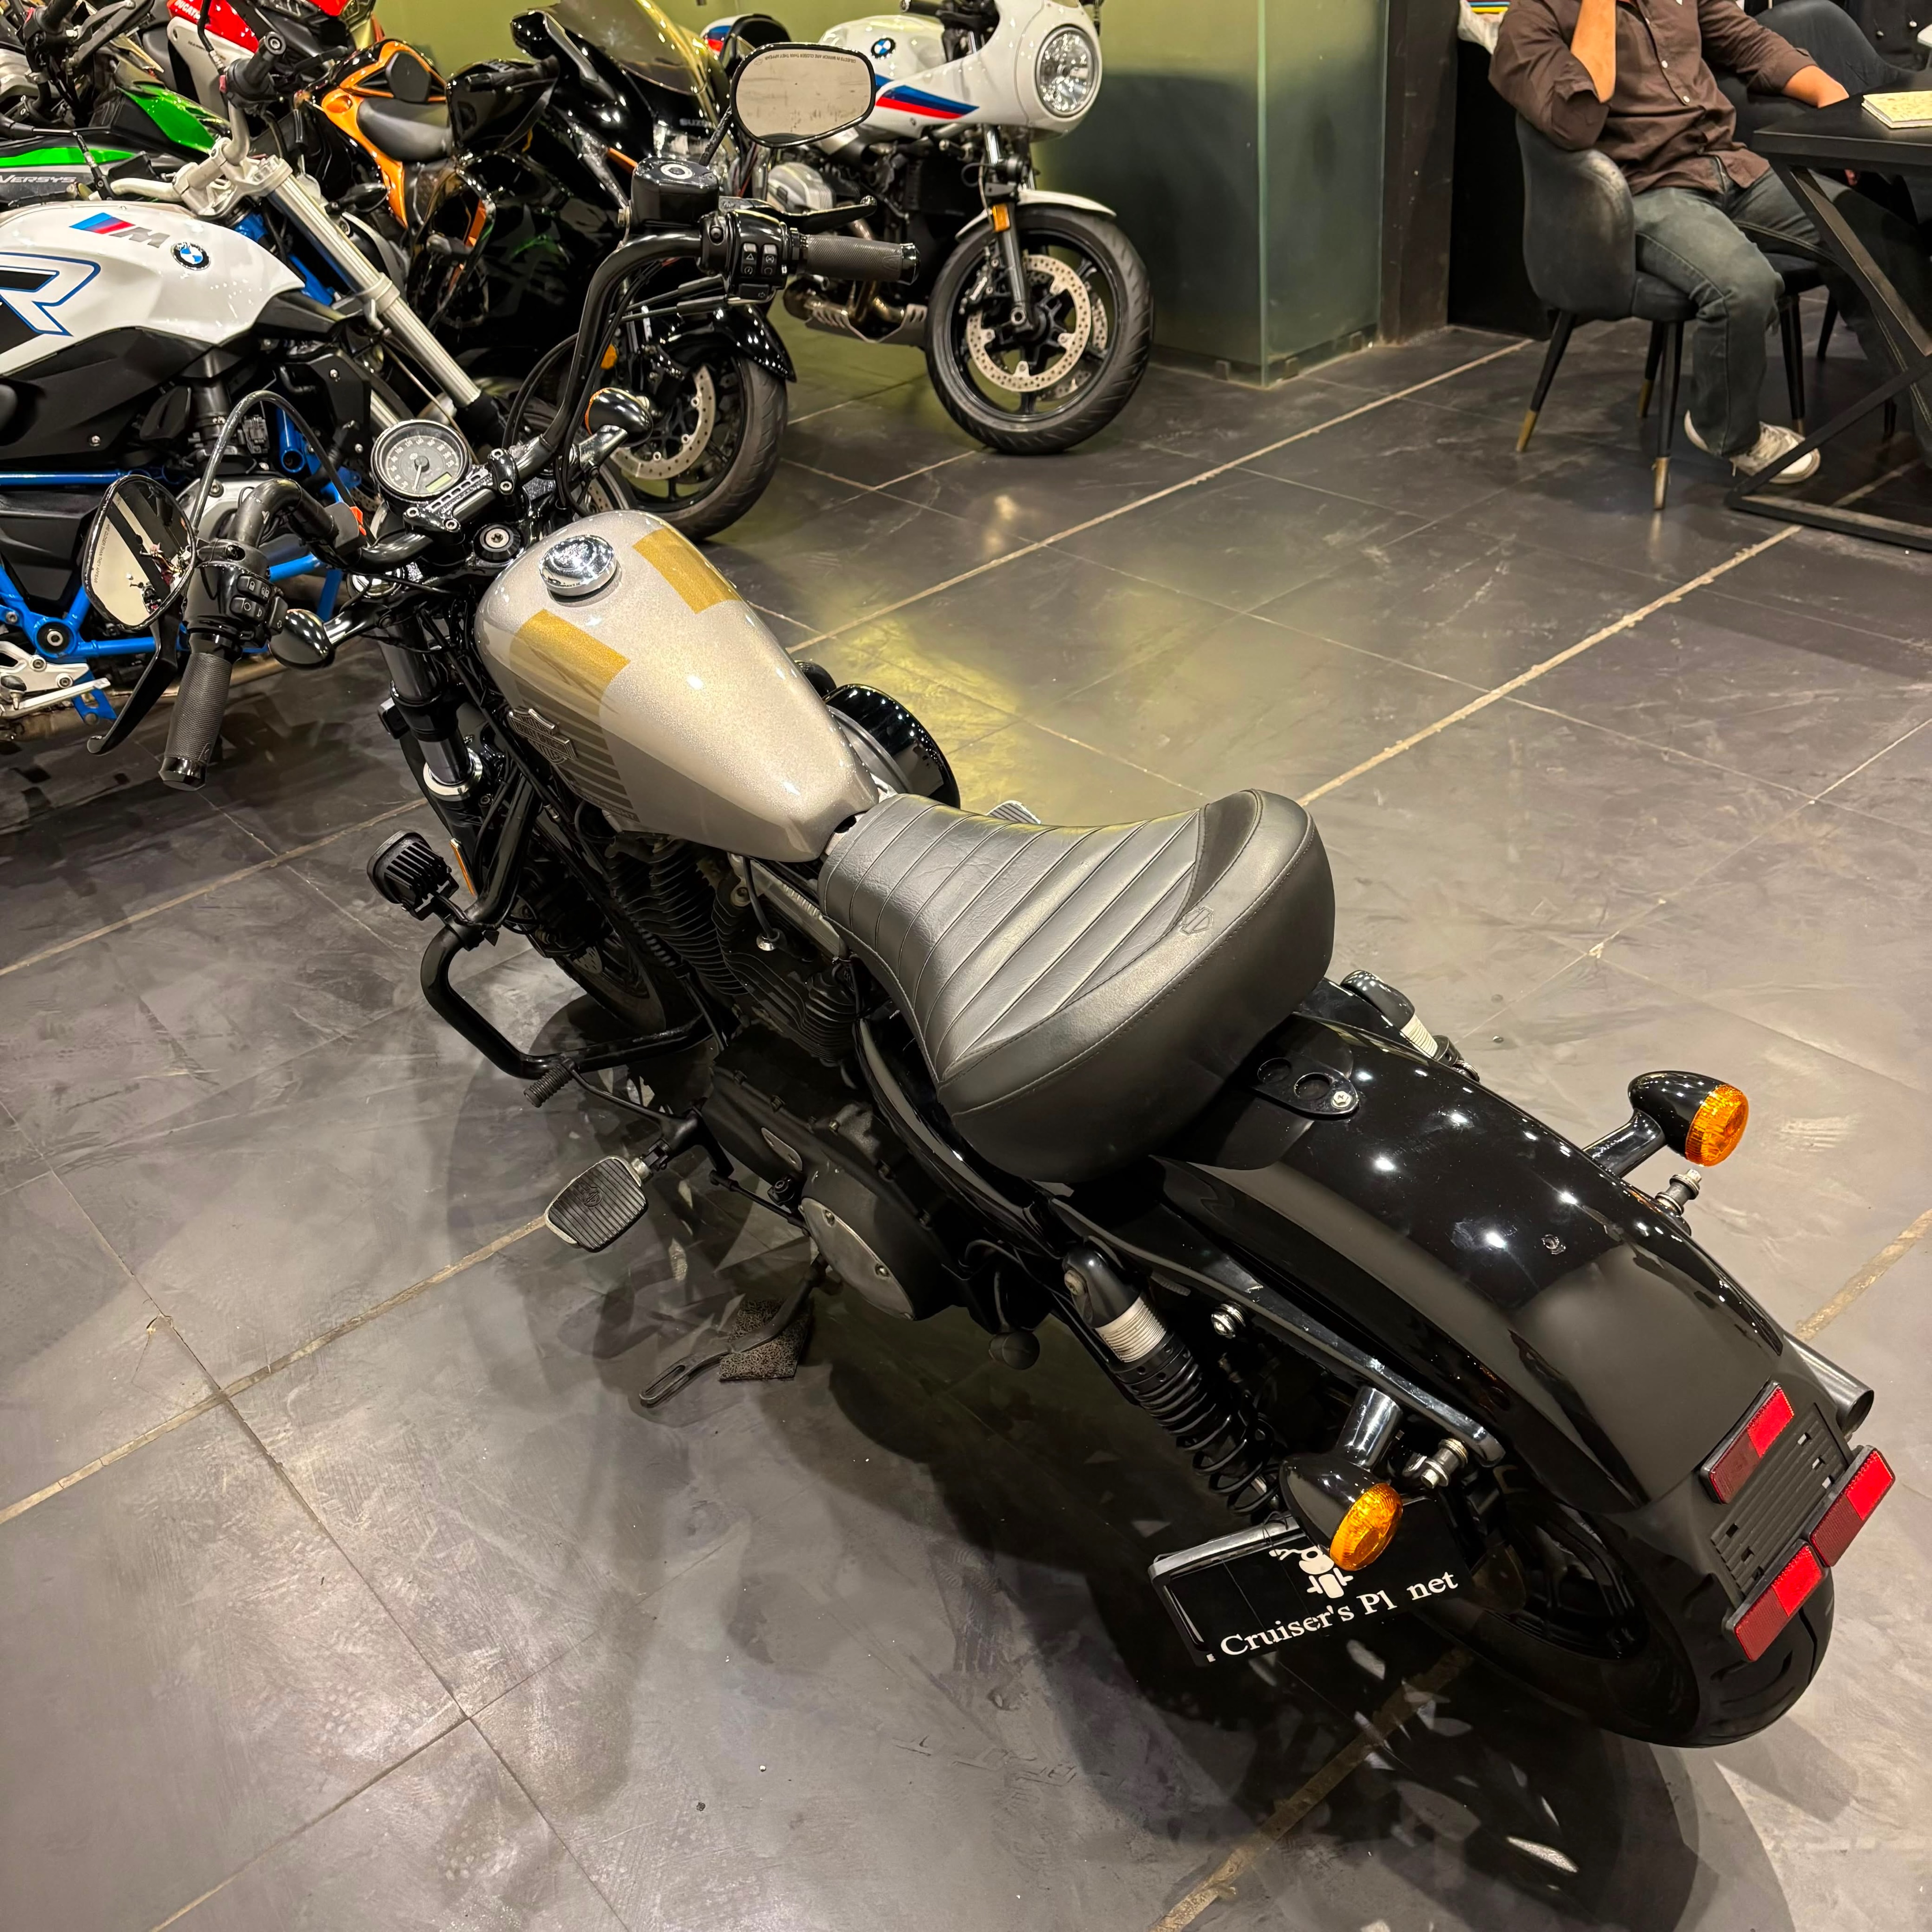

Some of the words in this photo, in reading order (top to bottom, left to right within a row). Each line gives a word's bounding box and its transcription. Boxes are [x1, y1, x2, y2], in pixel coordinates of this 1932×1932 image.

[0, 175, 76, 183] VERSYS
[405, 440, 413, 448] 120
[1221, 1605, 1355, 1655] Cruiser's
